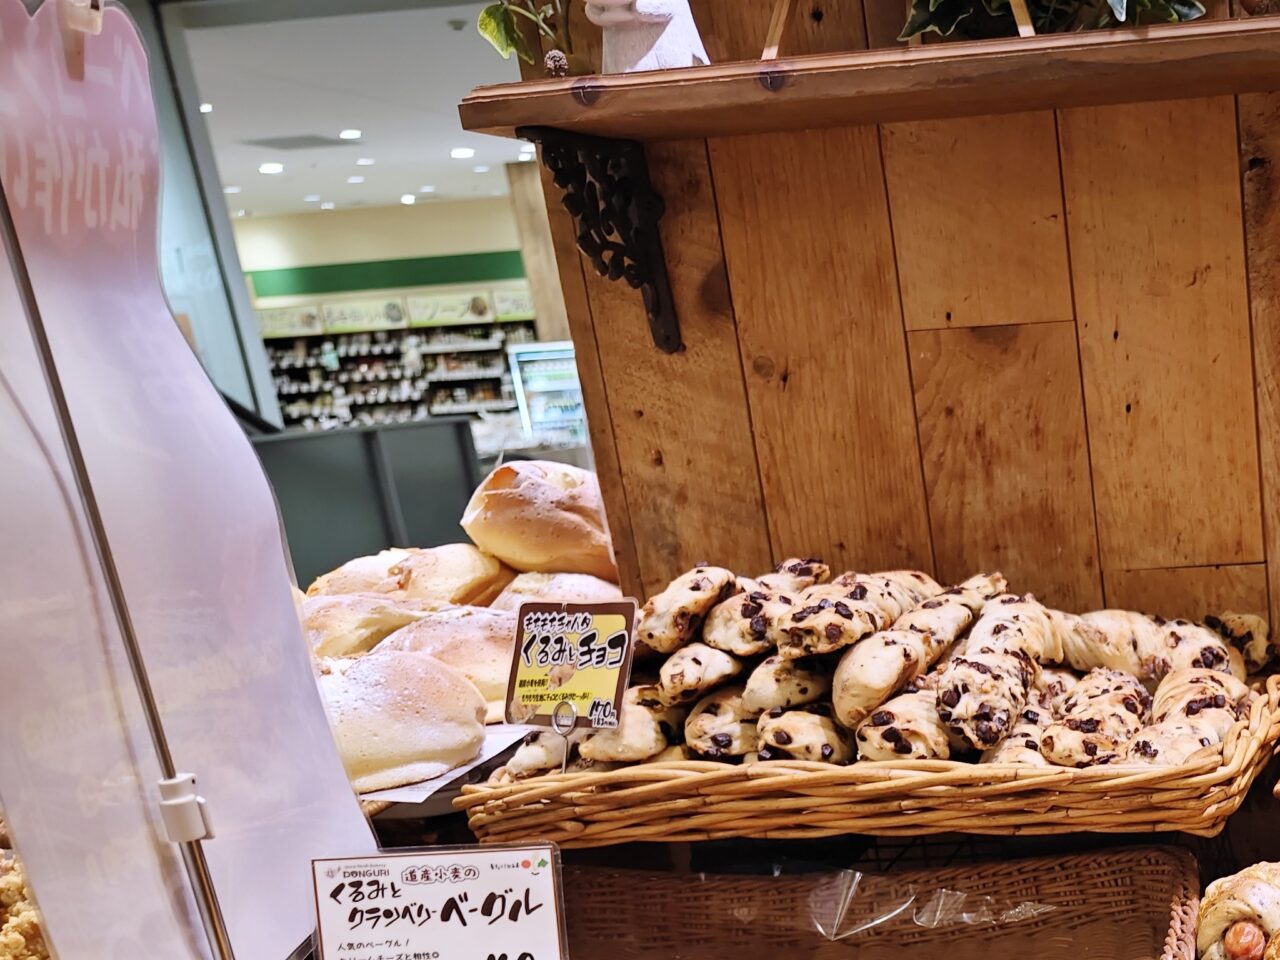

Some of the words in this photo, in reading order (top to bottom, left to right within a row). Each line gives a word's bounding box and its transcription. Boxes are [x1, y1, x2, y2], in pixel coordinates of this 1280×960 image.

[523, 632, 626, 667] くるみとチョコ
[343, 869, 390, 879] DONGURI
[404, 867, 478, 882] 道産小麦の
[329, 879, 403, 904] くるみと
